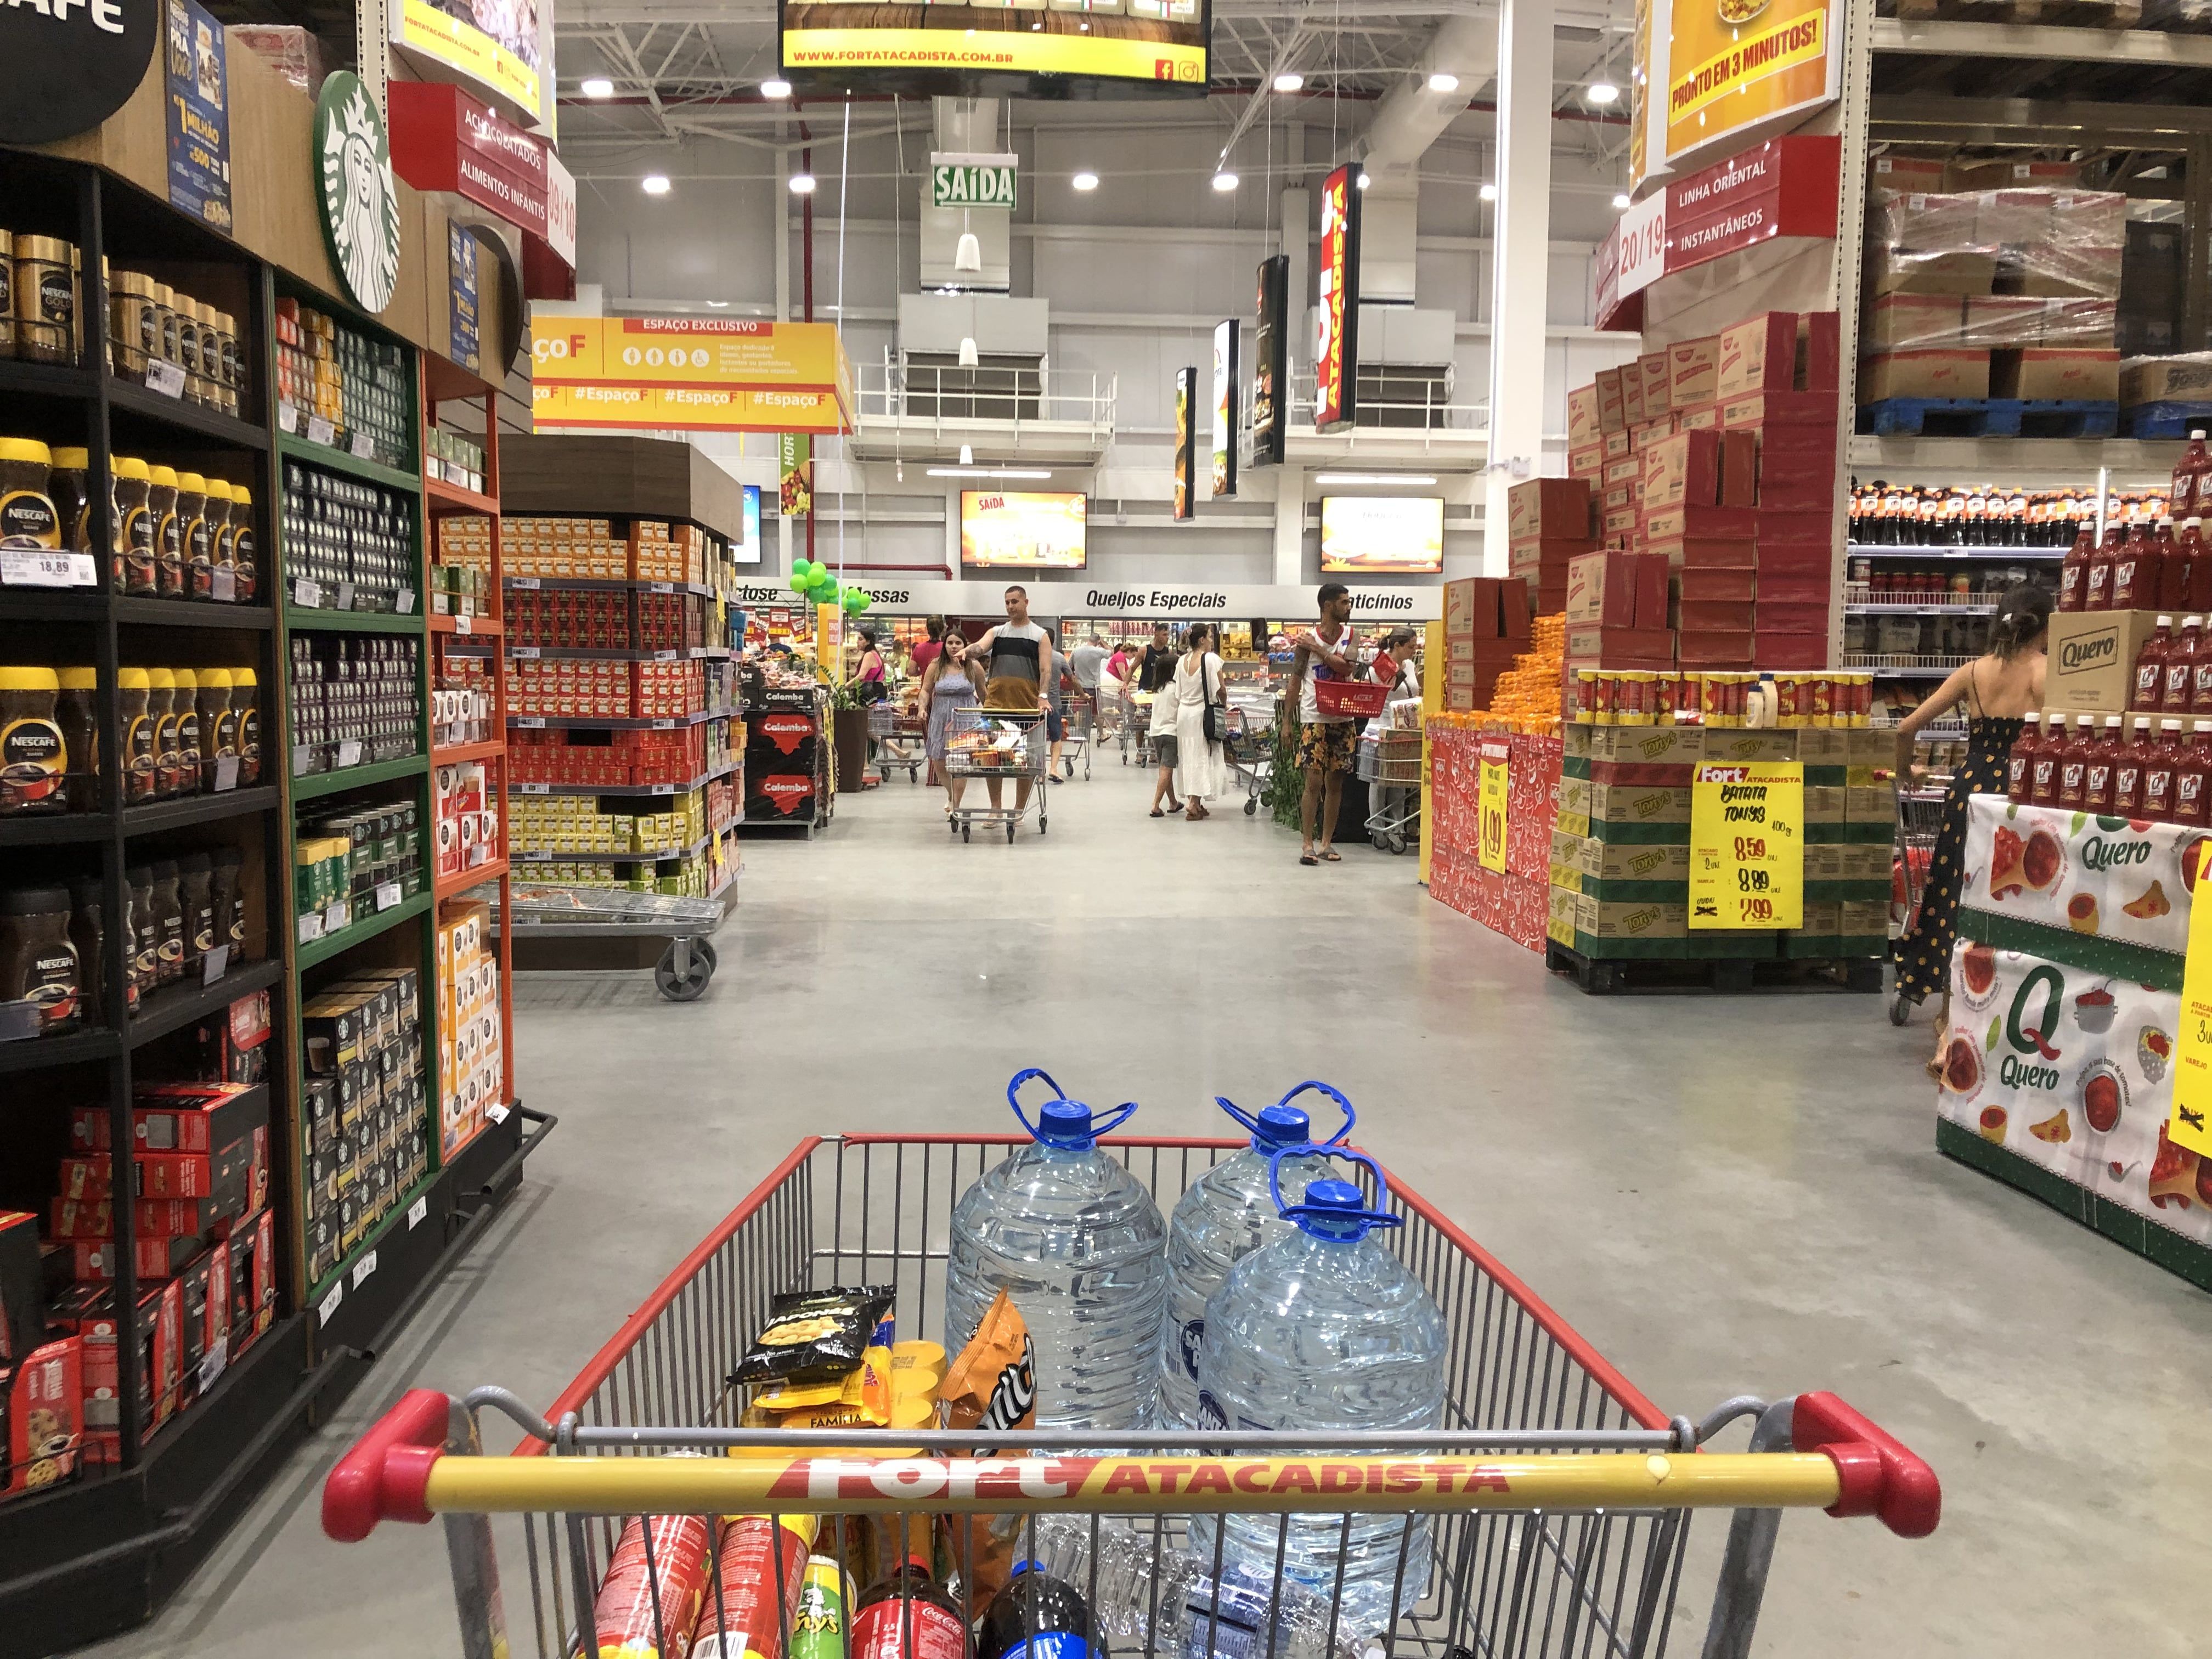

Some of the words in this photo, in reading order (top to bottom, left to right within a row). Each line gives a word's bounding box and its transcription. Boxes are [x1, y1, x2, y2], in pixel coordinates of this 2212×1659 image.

[793, 50, 1014, 64] WWW.FORTATACADISTA.COM.BR
[1672, 70, 1712, 112] PRONTO
[1714, 59, 1730, 87] EM
[1732, 53, 1741, 76] 3
[1743, 18, 1816, 72] MINUTOS!
[465, 109, 541, 170] ACHOCOLATADOS
[461, 159, 510, 201] ALIMENTOS
[511, 188, 546, 221] INFANTIS
[935, 166, 1014, 202] SAÍDA
[1679, 184, 1710, 208] LINHA
[1713, 160, 1767, 194] ORIENTAL
[549, 177, 575, 242] 09/10
[1680, 208, 1764, 252] INSTANTÂNEOS
[1621, 214, 1664, 277] 20/19
[1328, 181, 1345, 409] ATACADISTA
[643, 319, 690, 332] ESPAÇO
[691, 320, 758, 333] EXCLUSIVO
[574, 387, 648, 403] #EspaçoF
[664, 389, 738, 405] #EspaçoF
[753, 391, 826, 409] #EspaçoF
[784, 432, 794, 466] HOR
[979, 497, 1005, 511] SAÍDA
[737, 584, 777, 601] ctose
[1086, 589, 1146, 610] Queijos
[1149, 591, 1227, 609] Especiais
[1348, 593, 1414, 610] aticínios
[2062, 637, 2116, 668] Quero
[766, 692, 804, 701] Calemba
[764, 723, 808, 732] Calemba
[1638, 731, 1678, 756] Tony's
[764, 781, 808, 793] Calemba
[1702, 766, 1744, 783] Fort
[1633, 791, 1672, 815] Tony's
[1720, 785, 1768, 804] BATATA
[1724, 805, 1766, 823] TONYS
[1628, 848, 1667, 873] Tony's
[2082, 836, 2152, 872] Quero
[1623, 905, 1662, 932] Tony's
[2191, 1001, 2212, 1013] ATACA
[2000, 1055, 2060, 1091] Quero
[2185, 1056, 2208, 1070] VAREJO
[808, 1458, 1068, 1499] Fort
[1101, 1463, 1511, 1494] ATACADISTA
[794, 1610, 839, 1635] ny's
[922, 1606, 962, 1635] Coca-Cola
